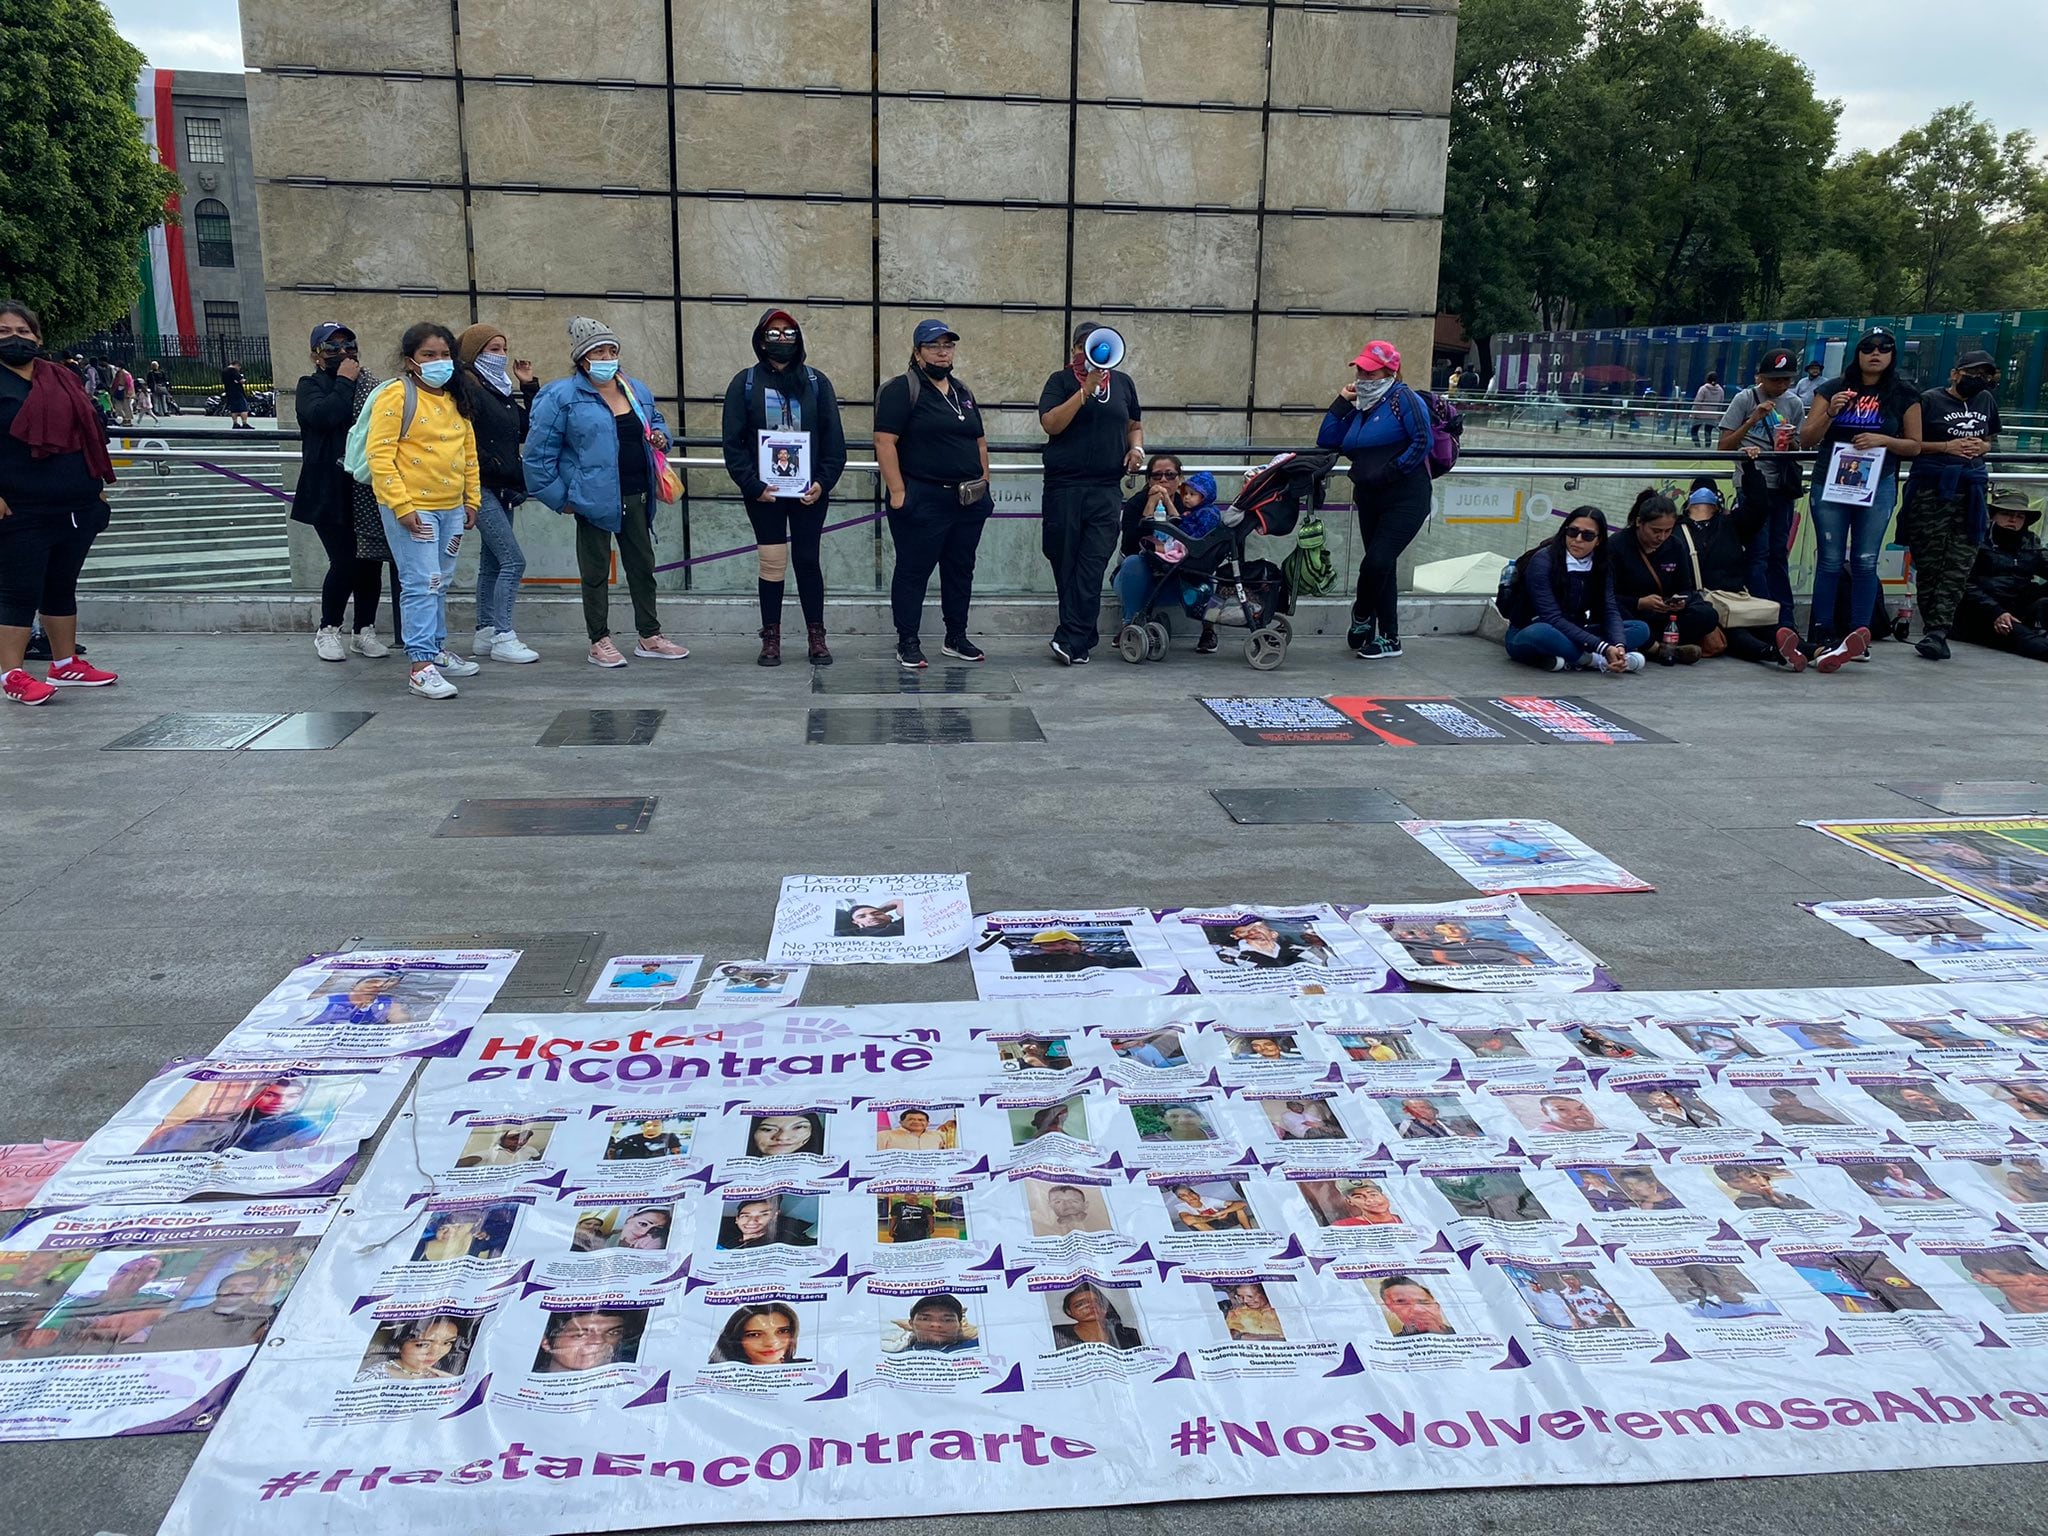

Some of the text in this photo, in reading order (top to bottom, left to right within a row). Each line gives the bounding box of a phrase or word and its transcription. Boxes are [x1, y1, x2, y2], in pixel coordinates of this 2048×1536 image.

[1943, 411, 1988, 423] HOLLISTER
[1947, 427, 1985, 437] COMPANY
[1455, 494, 1500, 506] JUGAR
[786, 884, 870, 893] MARCOS
[478, 1028, 724, 1062] Hasta
[467, 1043, 935, 1084] encontrarte
[106, 1158, 159, 1166] Desapareció
[246, 1204, 289, 1212] Hasta
[53, 1216, 212, 1231] DESAPARECIDO
[49, 1226, 285, 1247] Carlos Rodríguez Mendoza
[1637, 1257, 1665, 1265] Héctor
[1665, 1256, 1692, 1264] Daniel
[1333, 1262, 1406, 1271] DESAPARECIDO
[1180, 1268, 1254, 1277] DESAPARECIDO
[1345, 1270, 1390, 1280] Juan Carlos
[868, 1279, 946, 1288] DESAPARECIDO
[1116, 1281, 1140, 1289] López
[706, 1285, 785, 1296] DESAPARECIDO
[927, 1286, 951, 1294] pirita
[951, 1285, 985, 1293] Jimenez
[543, 1293, 624, 1302] DESAPARECIDO
[706, 1297, 734, 1305] Nataly
[735, 1293, 774, 1303] Alejandra
[376, 1299, 458, 1311] DESAPARECIDA
[541, 1301, 578, 1309] Leonardo
[609, 1299, 636, 1307] Zavala
[400, 1309, 439, 1317] Alejandra
[1038, 1347, 1080, 1360] Desapareció
[1133, 1346, 1151, 1354] 2020
[1198, 1343, 1246, 1354] Desapareció
[1305, 1342, 1327, 1350] 2020
[1066, 1350, 1136, 1362] Irapuato, Guanajuato.
[1210, 1351, 1239, 1361] colonia
[1249, 1359, 1297, 1367] Guanajuato.
[335, 1386, 381, 1396] Desapareció
[410, 1384, 435, 1392] agosto
[519, 1387, 541, 1395] Señas:
[588, 1382, 615, 1391] corazón
[345, 1393, 378, 1402] Irapuato,
[380, 1391, 425, 1399] Guanajuato.
[517, 1393, 546, 1401] derecha.
[1170, 1386, 2048, 1458] #NosVolveremosaAbra
[258, 1421, 1099, 1502] #HastaEncontrarte
